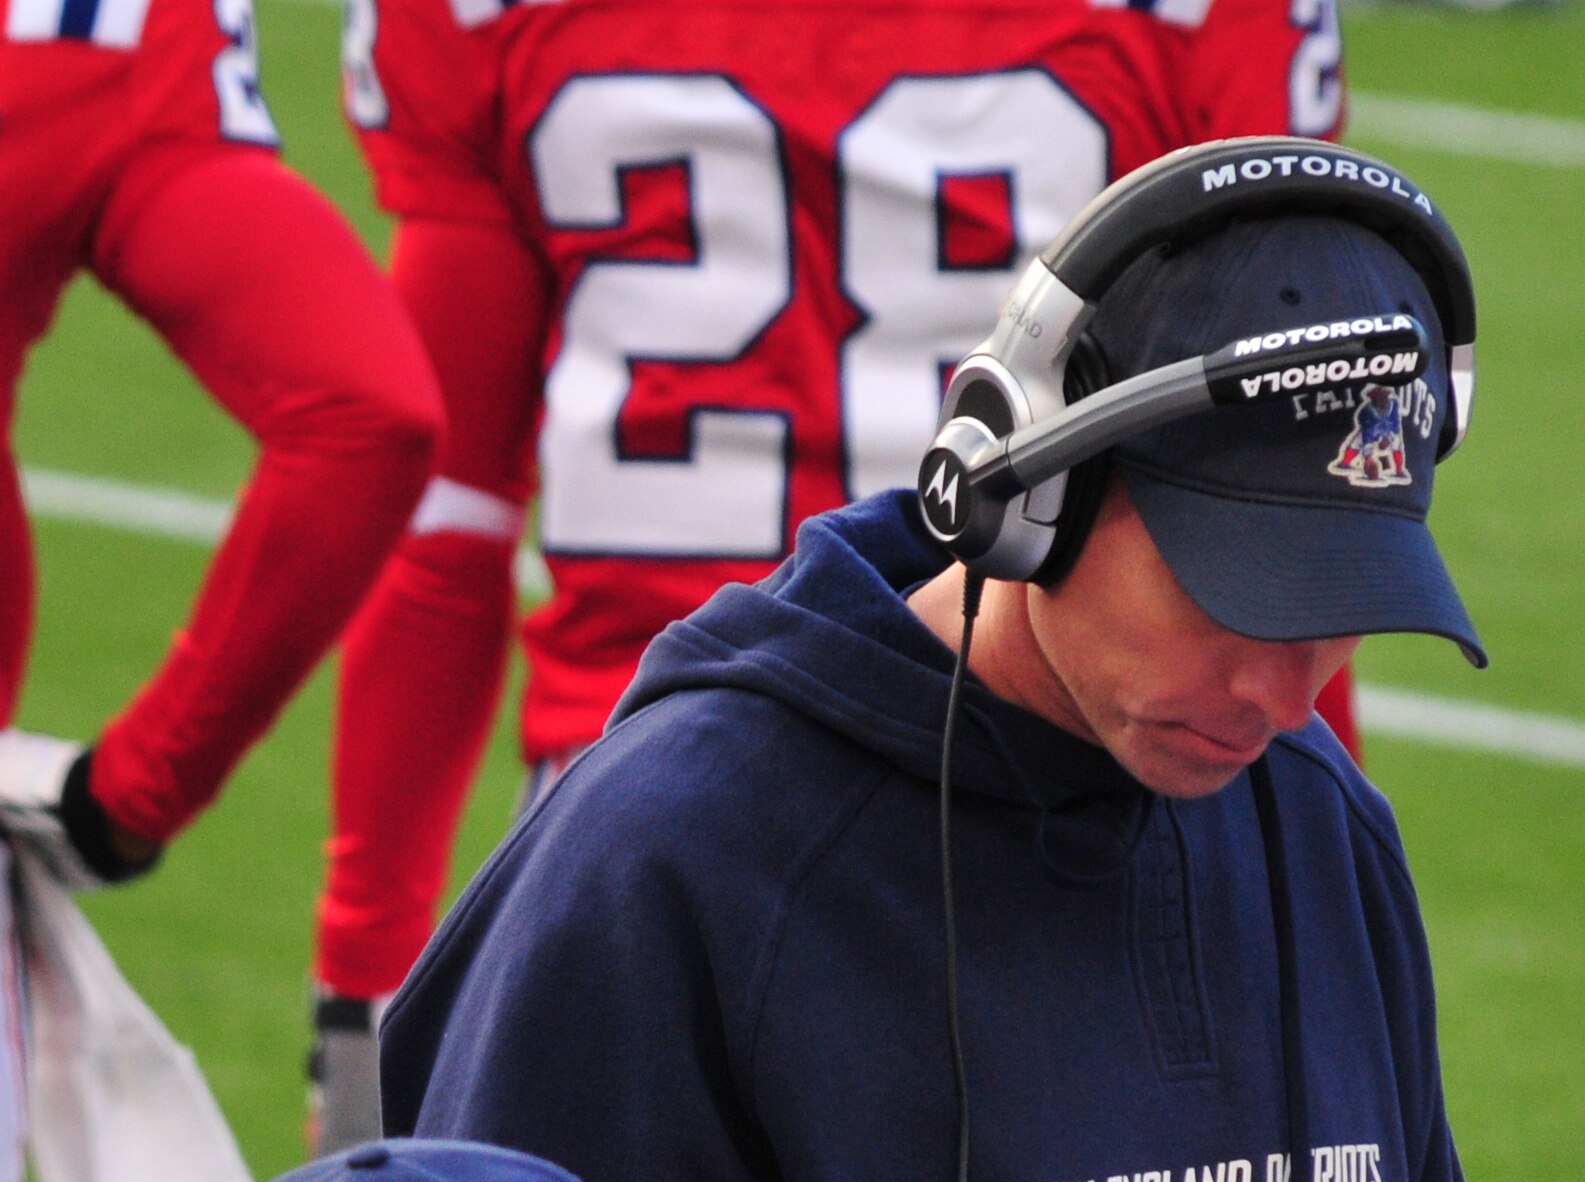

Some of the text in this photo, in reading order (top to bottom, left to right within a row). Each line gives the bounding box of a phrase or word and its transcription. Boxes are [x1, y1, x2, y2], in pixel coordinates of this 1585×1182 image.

[1202, 155, 1434, 217] MOTOROLA
[525, 63, 1110, 560] 28
[1234, 315, 1413, 358] MOTOROLA
[1240, 351, 1419, 400] MOTOROLA
